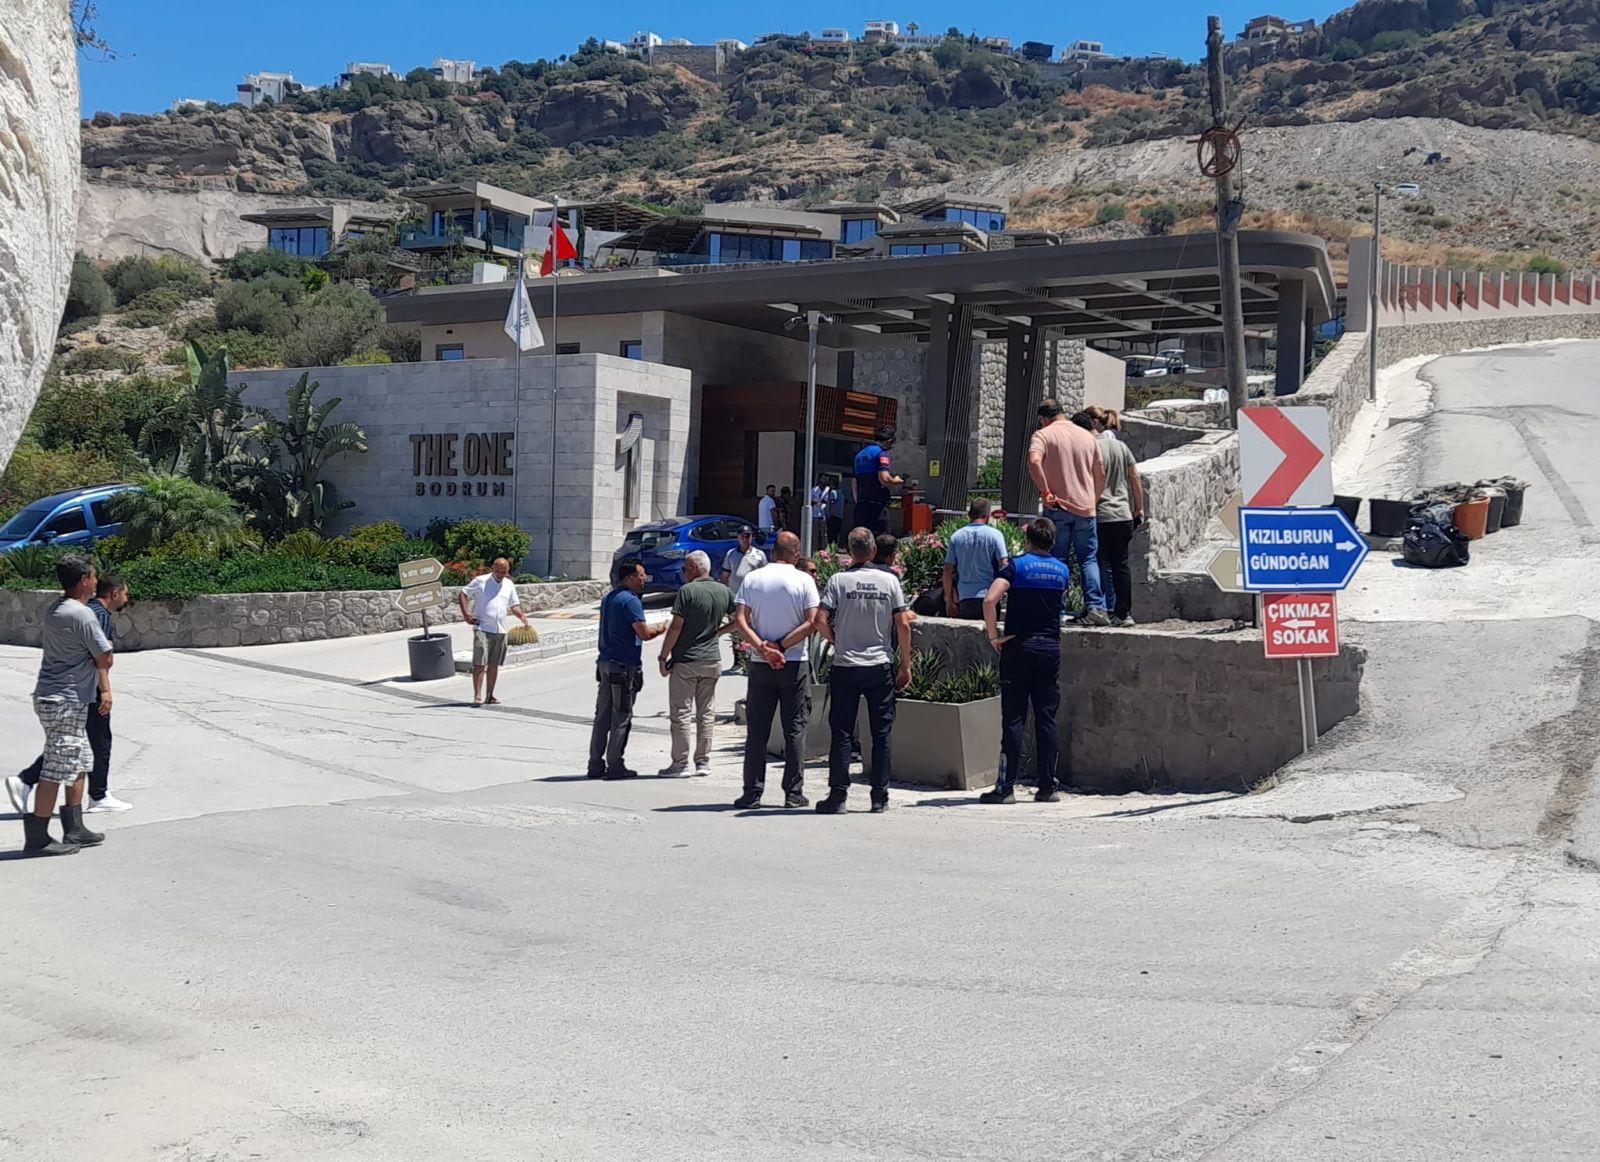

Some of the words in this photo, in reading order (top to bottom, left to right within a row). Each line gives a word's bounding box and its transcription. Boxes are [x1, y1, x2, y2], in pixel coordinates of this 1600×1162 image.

[409, 433, 458, 476] THE
[463, 432, 514, 476] ONE
[416, 481, 504, 496] BODRUM
[1249, 529, 1333, 544] KIZILBURUN
[1250, 552, 1329, 570] GÜNDOĞAN
[1268, 603, 1331, 622] ÇIKMAZ
[1272, 629, 1330, 645] SOKAK
